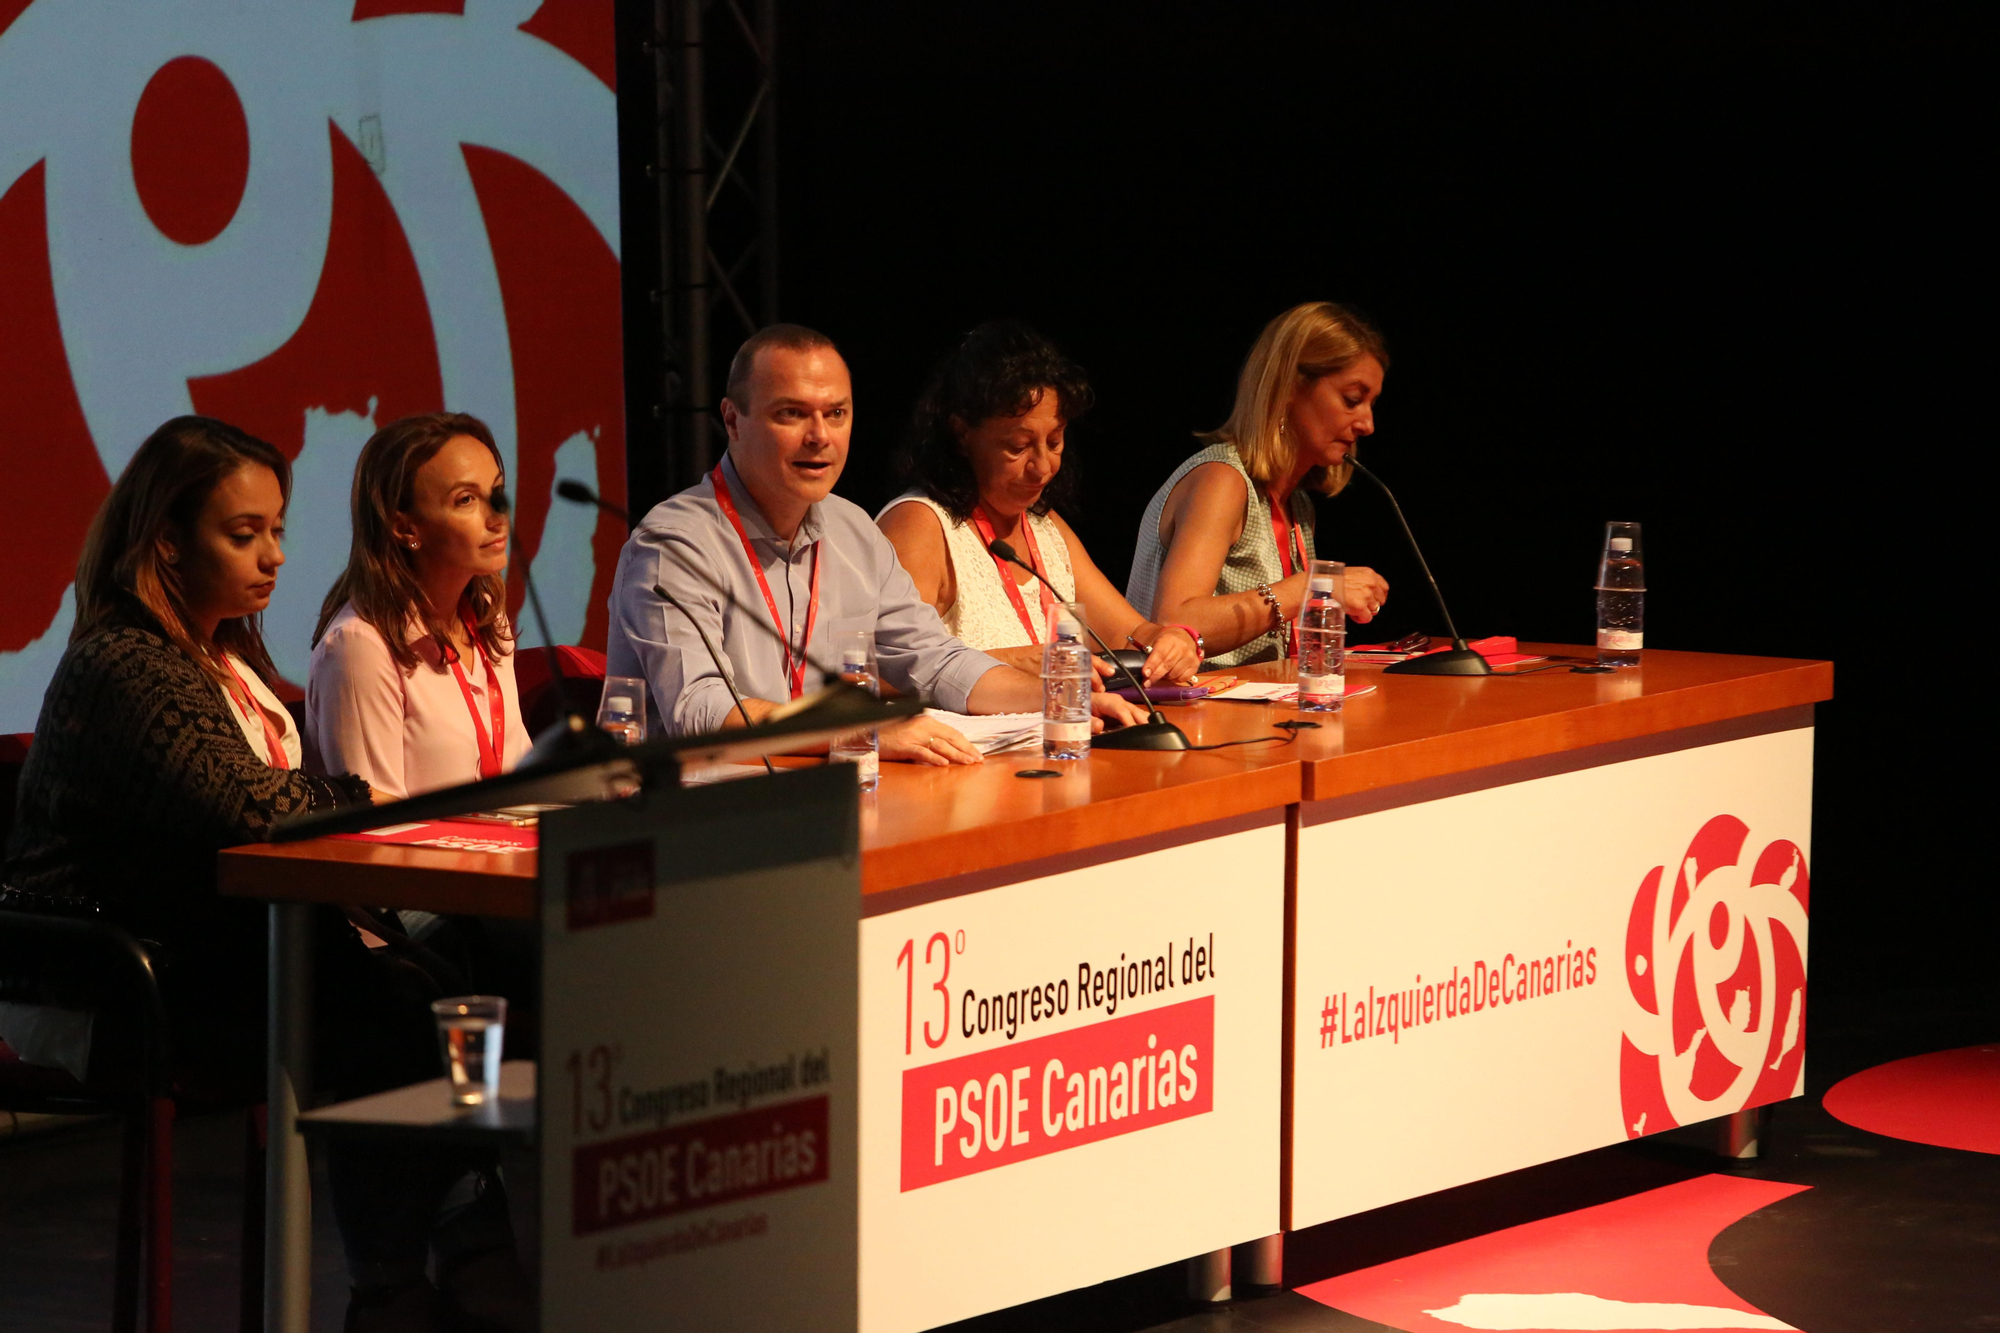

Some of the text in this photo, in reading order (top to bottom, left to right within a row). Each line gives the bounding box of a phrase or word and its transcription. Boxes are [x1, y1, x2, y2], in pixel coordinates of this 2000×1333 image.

[962, 988, 1069, 1040] Congreso
[1078, 941, 1175, 1016] Regional
[1182, 932, 1215, 985] del
[1319, 939, 1598, 1050] #LaIzquierdaDeCanarias
[618, 1082, 709, 1128] Congreso
[713, 1064, 796, 1110] Regional
[800, 1046, 831, 1088] del
[933, 1033, 1198, 1167] PSOE Canarias
[600, 1120, 817, 1219] PSOE Canarias
